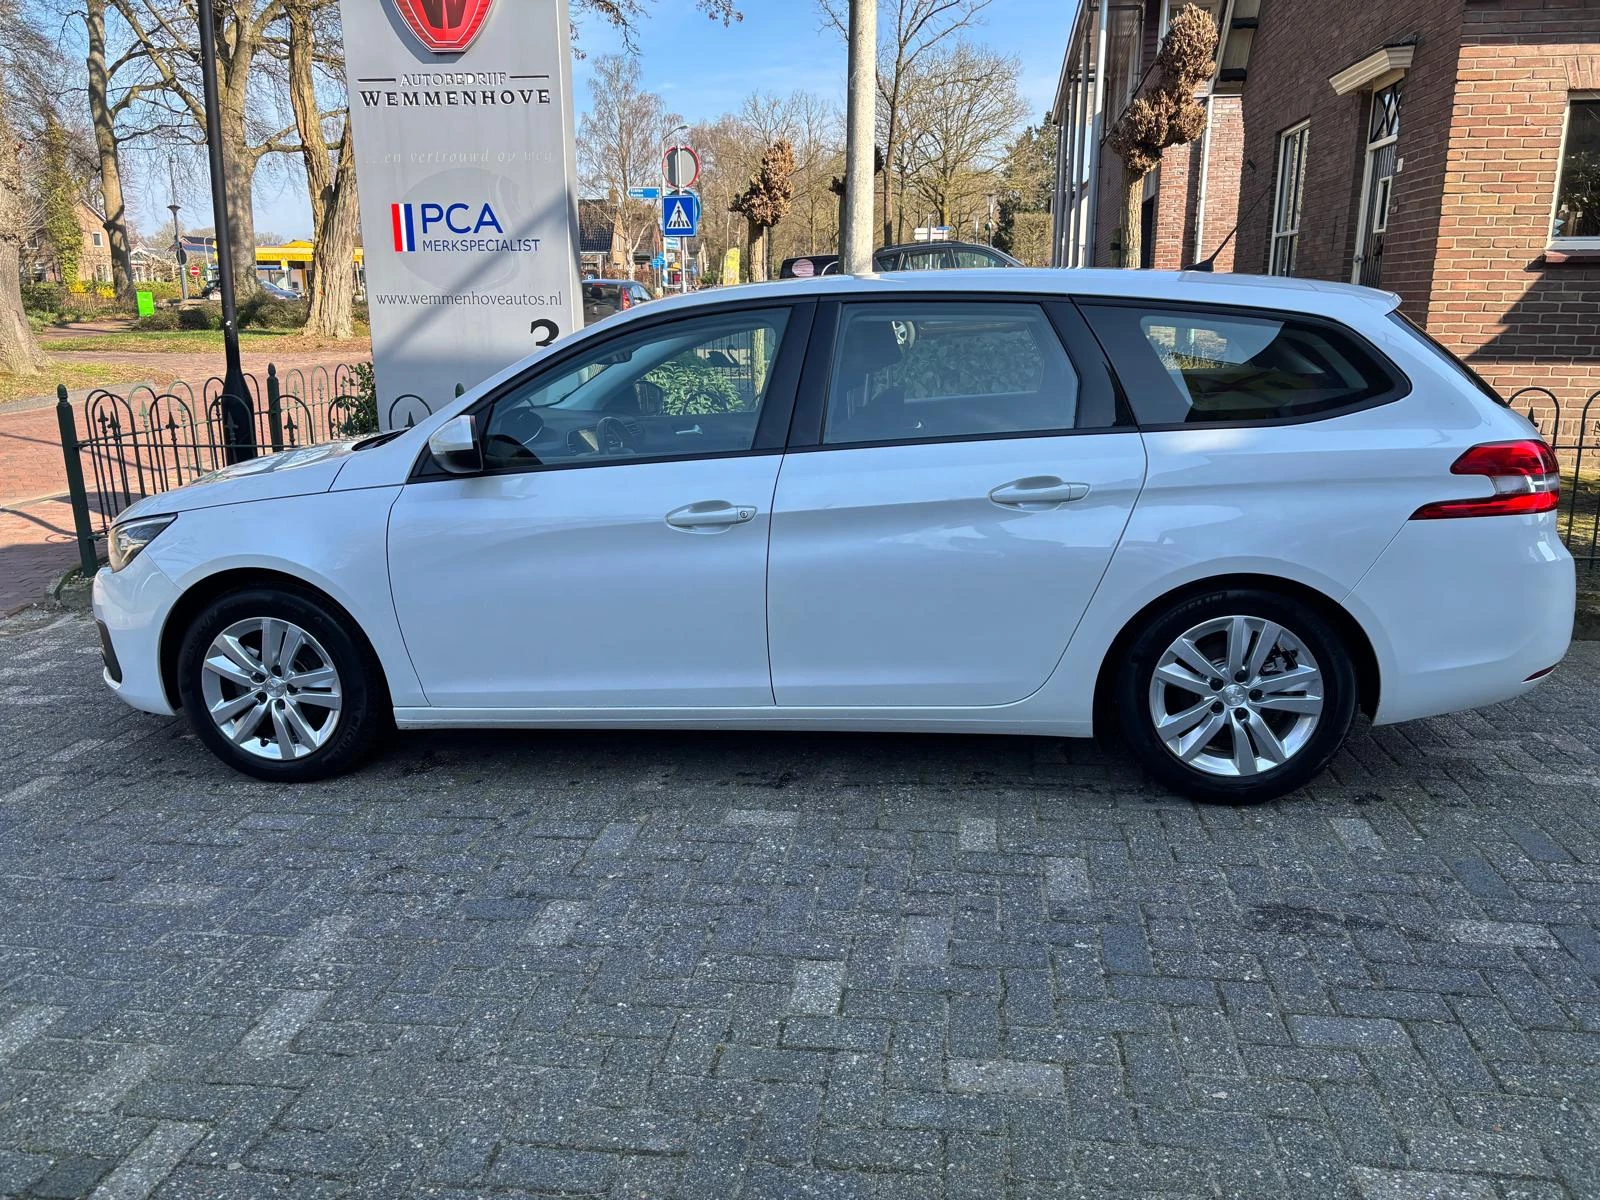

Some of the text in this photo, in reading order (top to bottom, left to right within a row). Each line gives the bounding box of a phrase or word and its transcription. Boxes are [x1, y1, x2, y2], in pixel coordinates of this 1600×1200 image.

[400, 72, 506, 87] AUTOBEDRIJF
[359, 89, 551, 107] WEMMENHOVE
[420, 203, 504, 234] PCA
[422, 239, 541, 252] MERKSPECIALIST
[376, 291, 562, 306] www.wemmenhoveautos.nl
